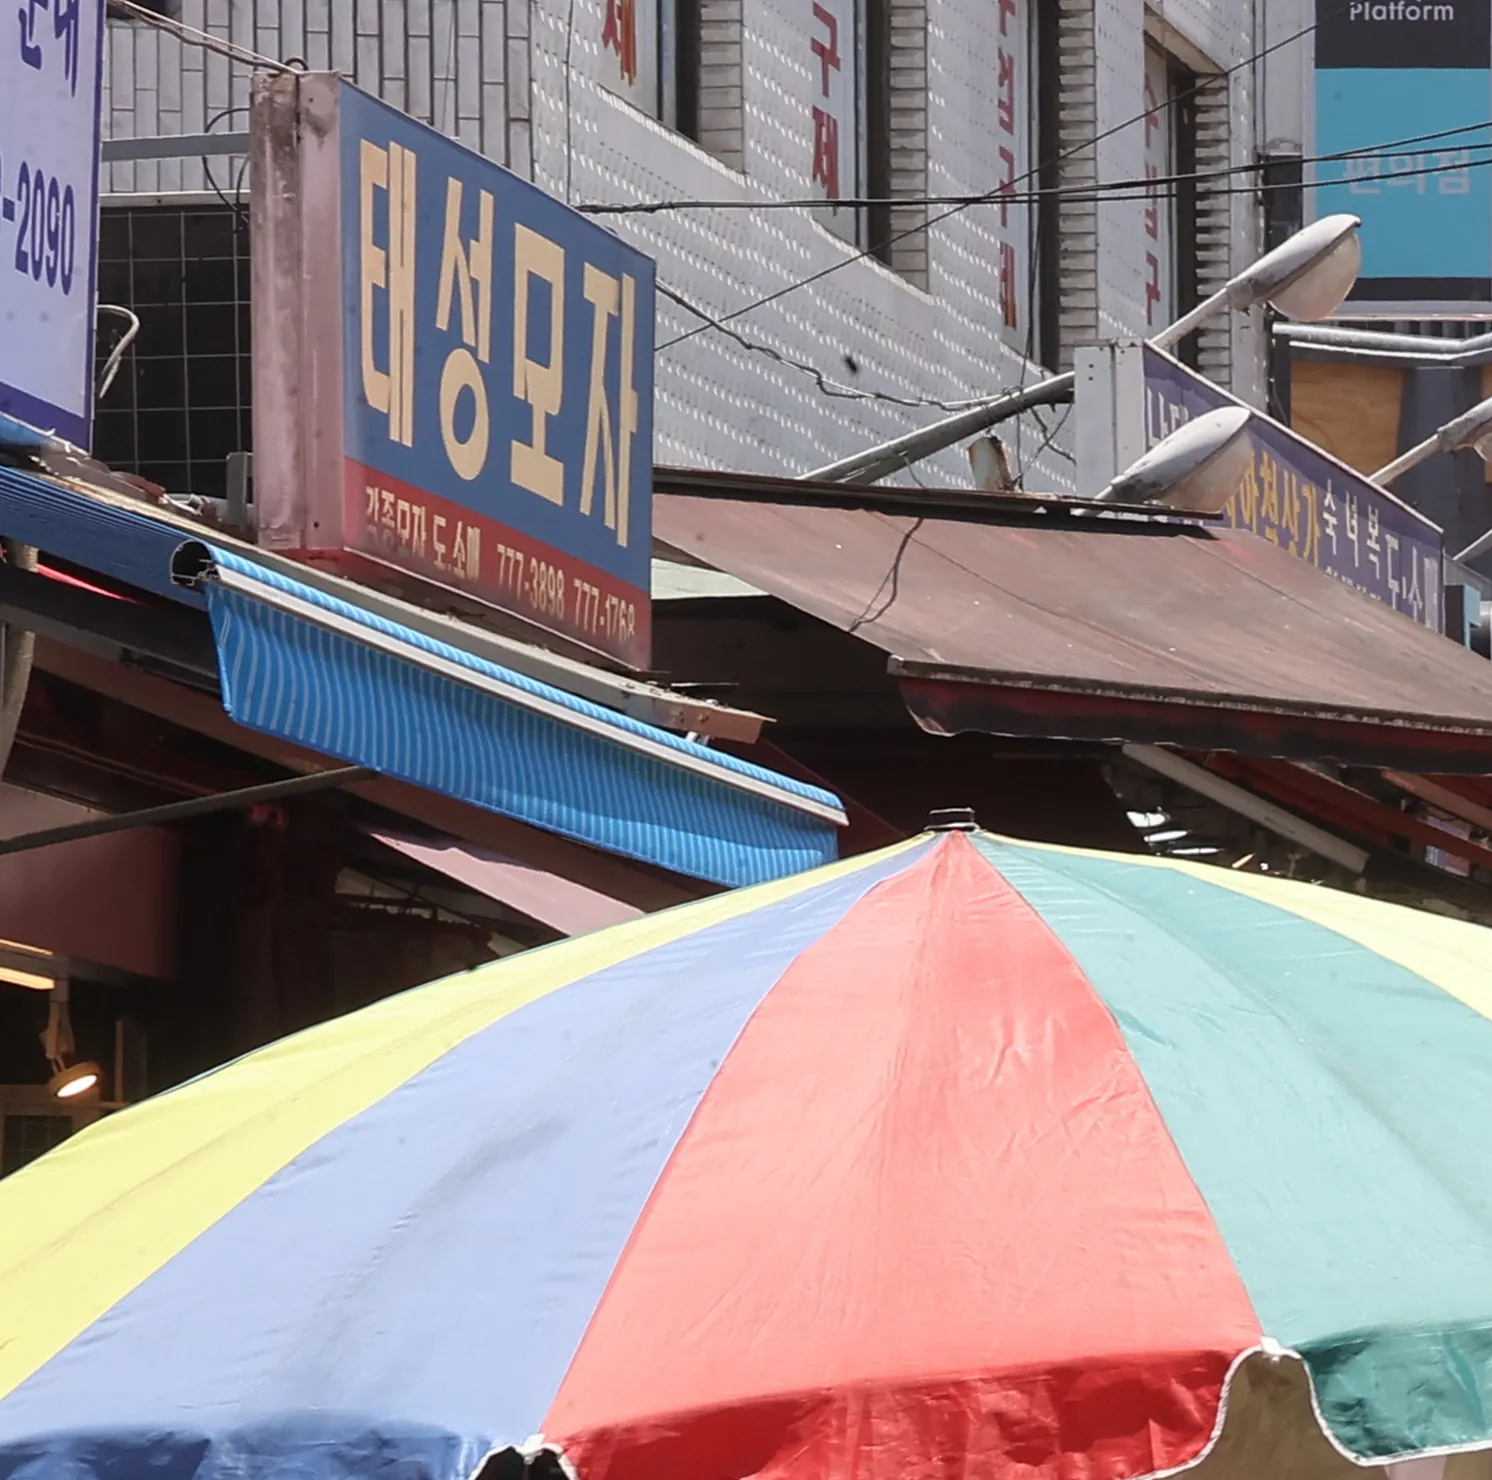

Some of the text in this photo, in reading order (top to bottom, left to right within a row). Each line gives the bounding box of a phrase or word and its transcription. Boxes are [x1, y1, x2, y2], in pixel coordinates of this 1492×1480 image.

[1350, 4, 1454, 21] Platform
[1343, 150, 1470, 195] 편의점
[359, 139, 639, 548] 태성모자
